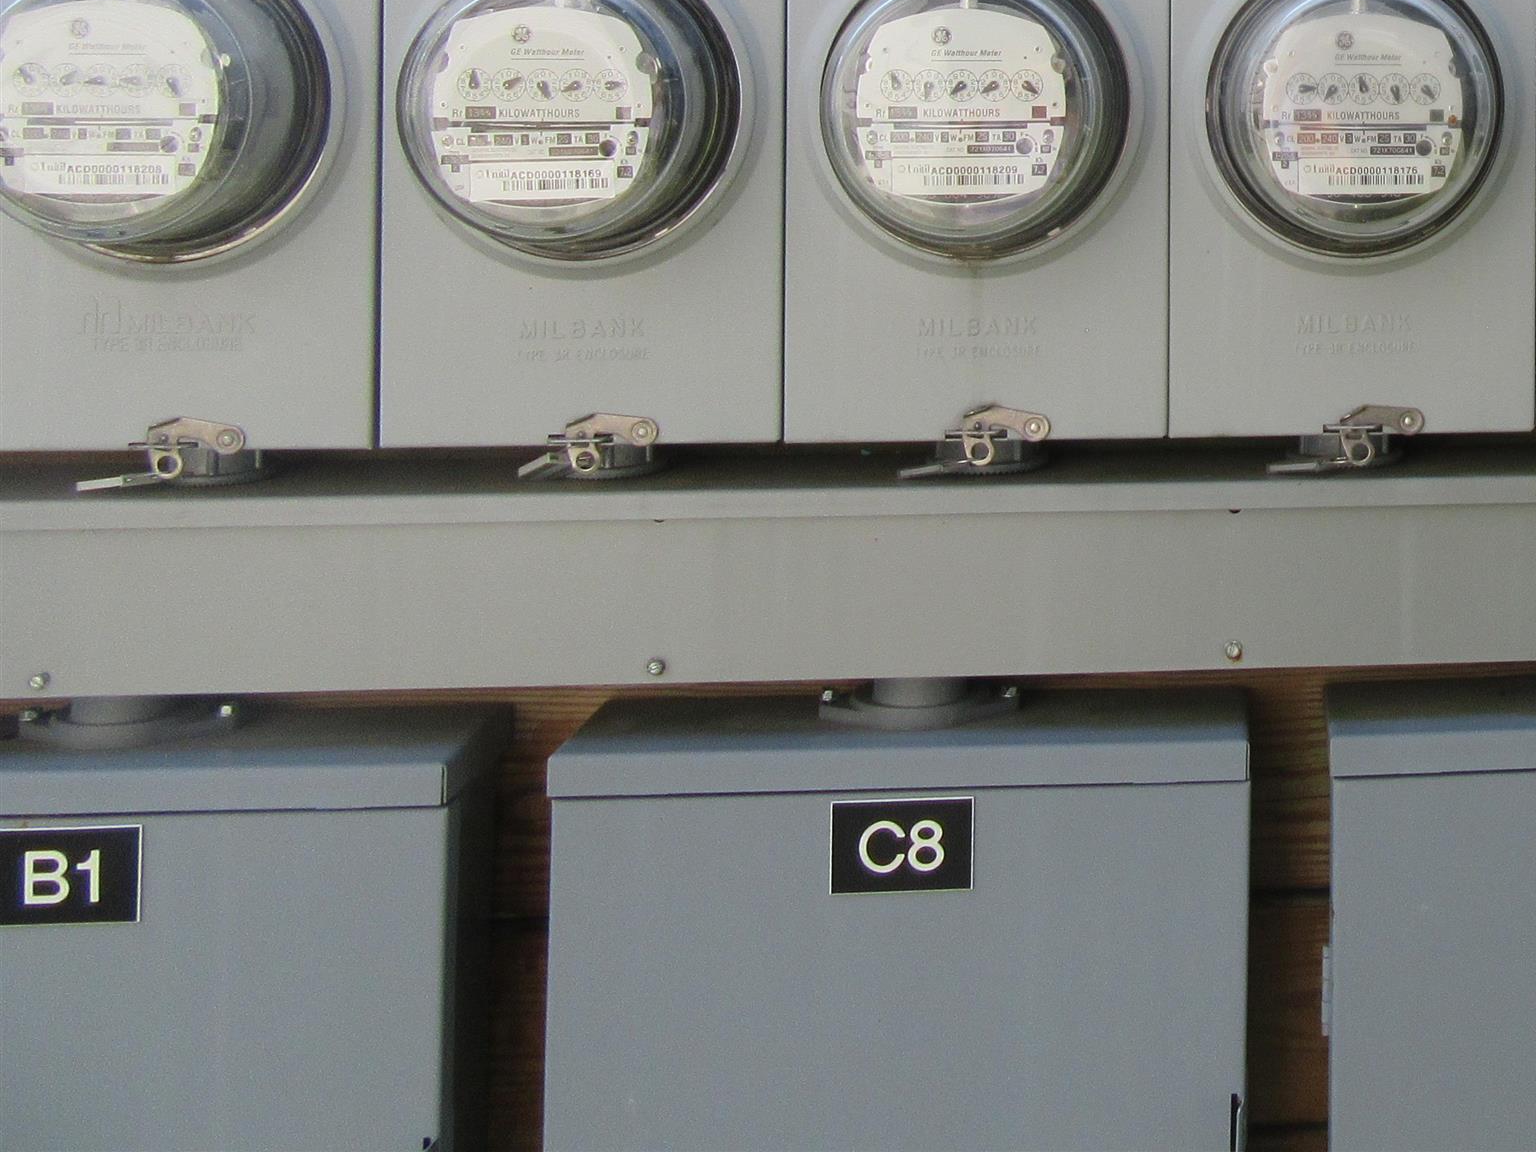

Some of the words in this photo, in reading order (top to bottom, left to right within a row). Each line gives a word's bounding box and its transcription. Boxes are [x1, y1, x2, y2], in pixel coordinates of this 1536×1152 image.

[499, 109, 580, 118] KILOWATTHOURS
[923, 108, 1000, 117] KILOWATTHOURS
[1327, 111, 1400, 120] KILOWATTHOURS
[512, 170, 601, 179] ACD0000118169
[932, 166, 1017, 174] ACD0000118209
[1336, 167, 1417, 175] ACD0000118176
[917, 316, 1037, 338] MILBANK
[1296, 312, 1413, 335] MILBANK
[518, 317, 646, 341] MILBANK
[858, 819, 945, 874] C8
[23, 849, 100, 905] B1
